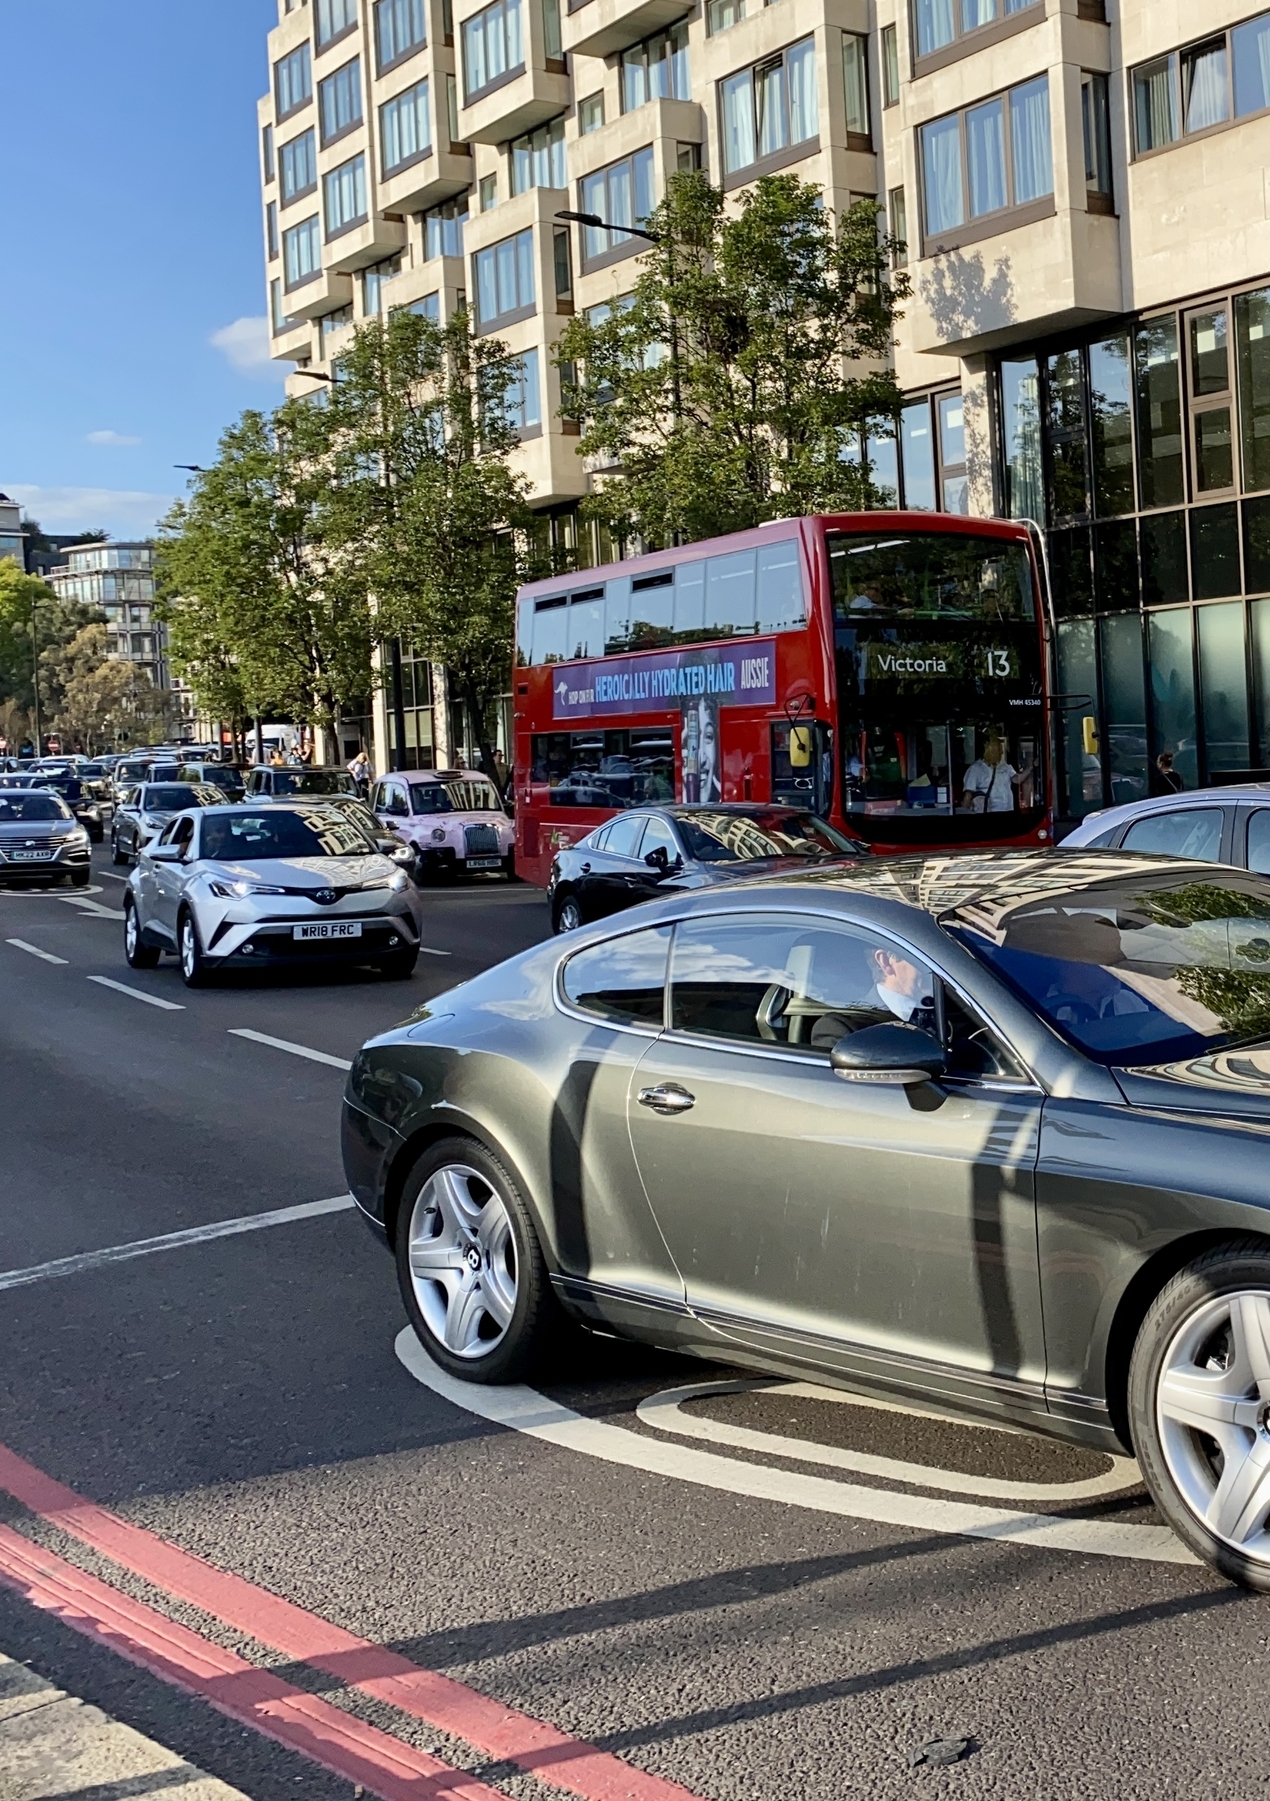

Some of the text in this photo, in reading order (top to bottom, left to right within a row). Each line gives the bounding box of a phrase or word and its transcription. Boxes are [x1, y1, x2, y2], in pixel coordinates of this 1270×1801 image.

[740, 657, 769, 689] AUSSIE
[877, 654, 947, 673] Victoria
[986, 650, 1011, 677] 13
[594, 671, 650, 702] HEROICALLY
[651, 664, 706, 697] HYDRATED
[706, 662, 736, 694] HAIR
[301, 924, 355, 938] WR18 FRC
